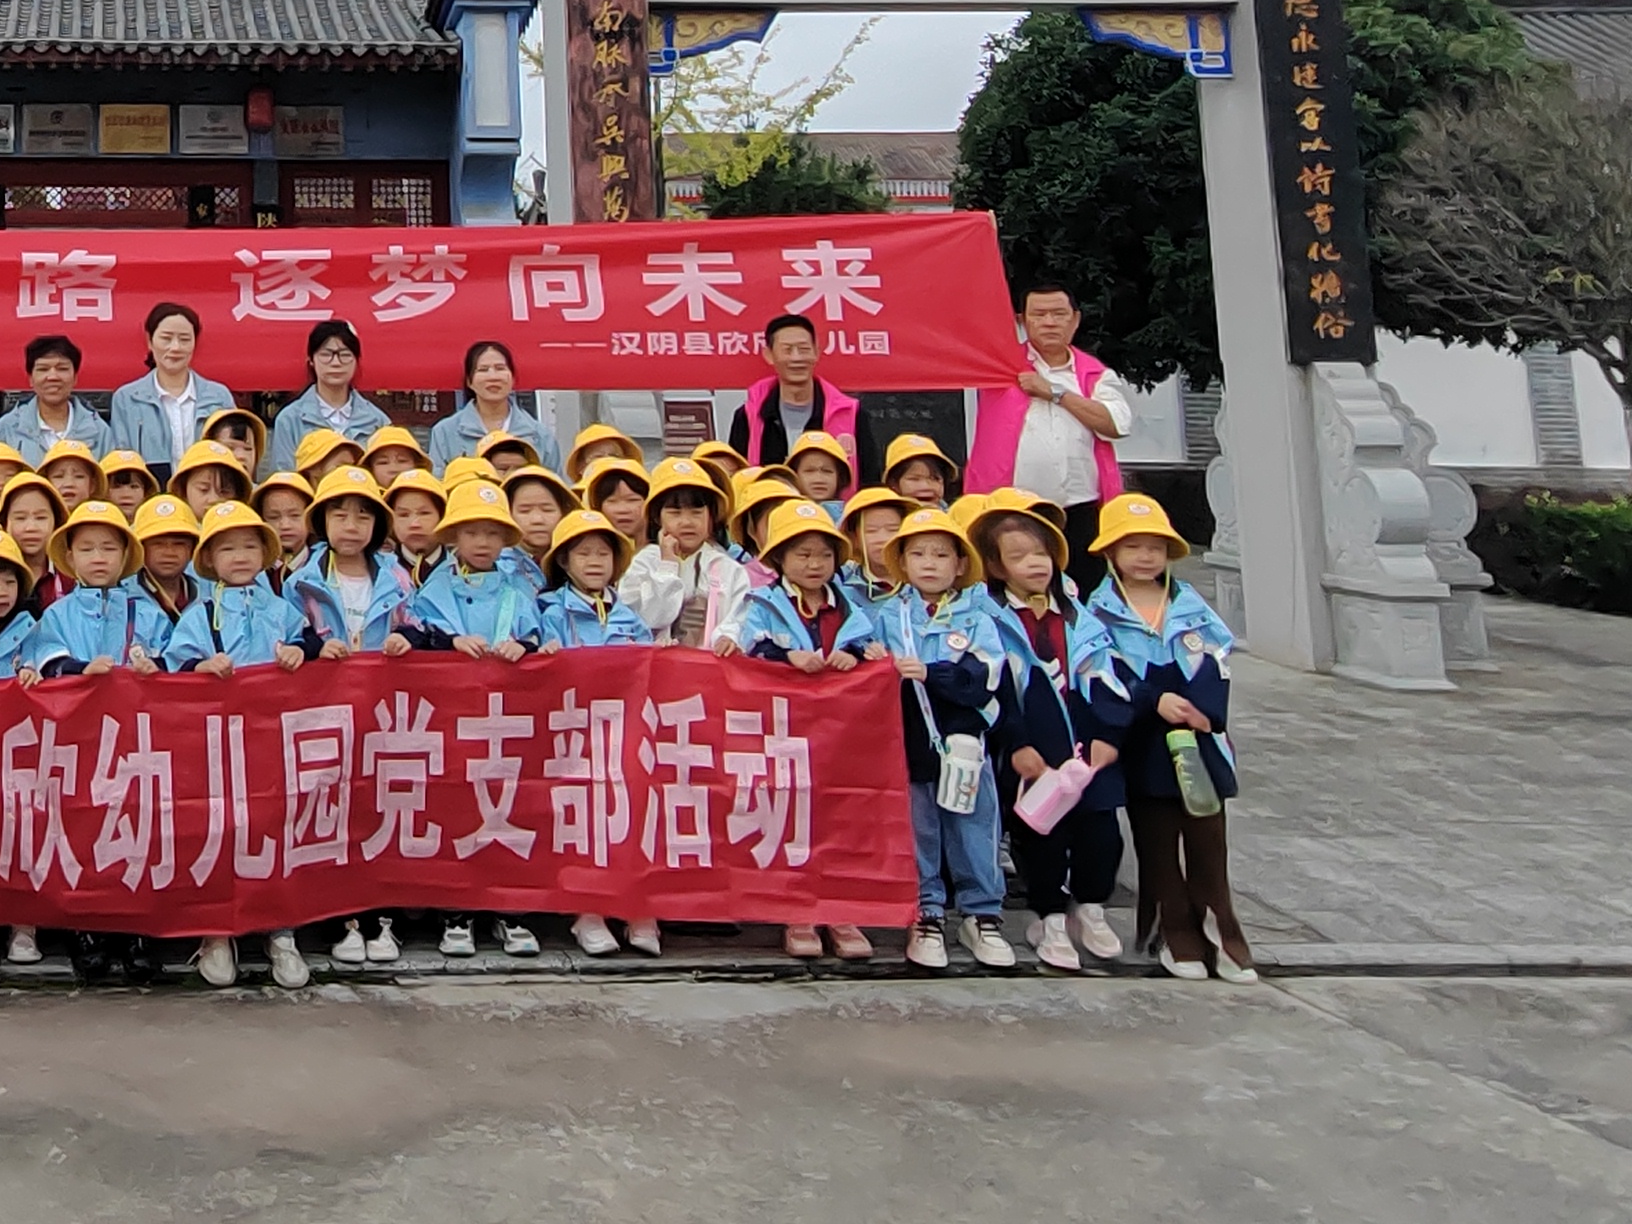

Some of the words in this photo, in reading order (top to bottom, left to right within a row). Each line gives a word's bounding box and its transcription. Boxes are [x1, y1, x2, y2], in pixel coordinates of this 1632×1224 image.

[231, 240, 884, 322] 逐梦向未来
